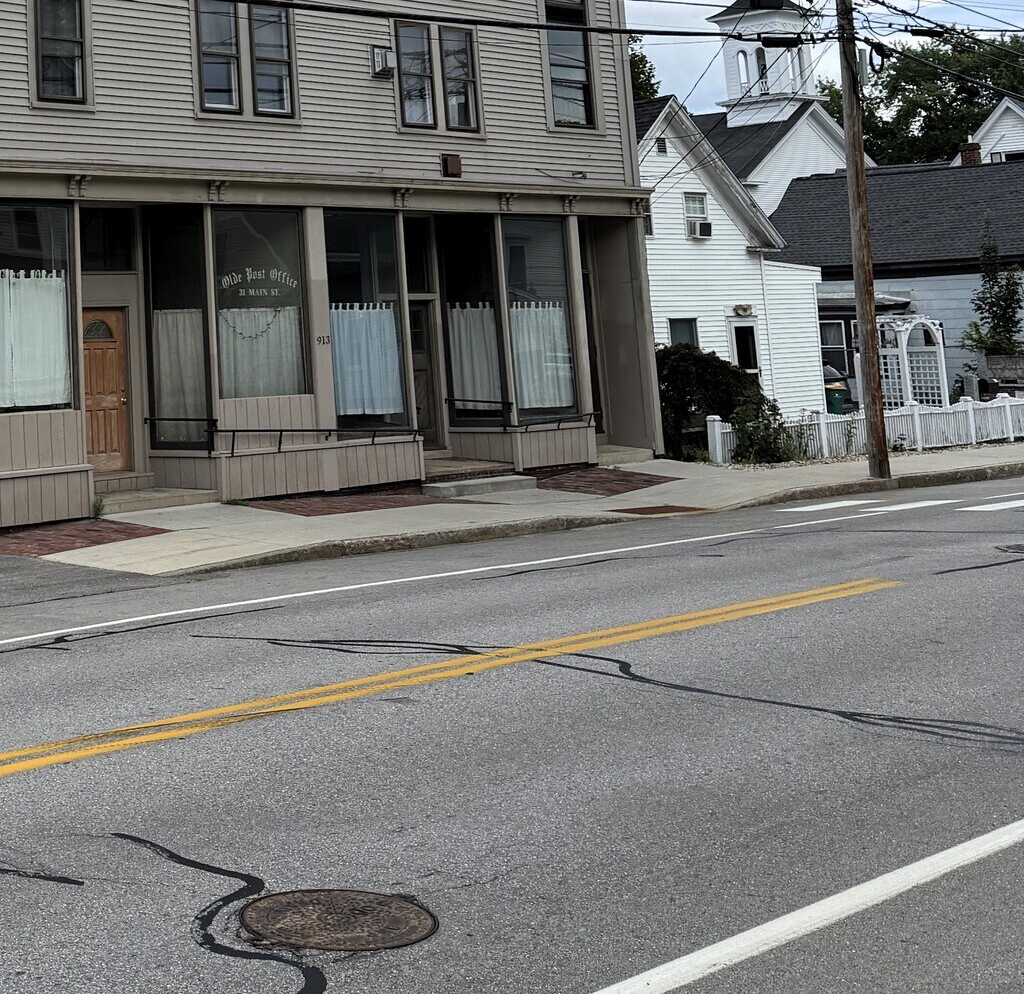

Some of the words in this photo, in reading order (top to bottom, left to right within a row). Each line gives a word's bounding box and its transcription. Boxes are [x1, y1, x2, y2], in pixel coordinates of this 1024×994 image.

[221, 272, 242, 288] Olde
[245, 267, 265, 282] Post
[269, 268, 297, 288] Office
[248, 288, 268, 296] MAIN
[270, 288, 281, 296] ST.
[316, 335, 331, 345] 913
